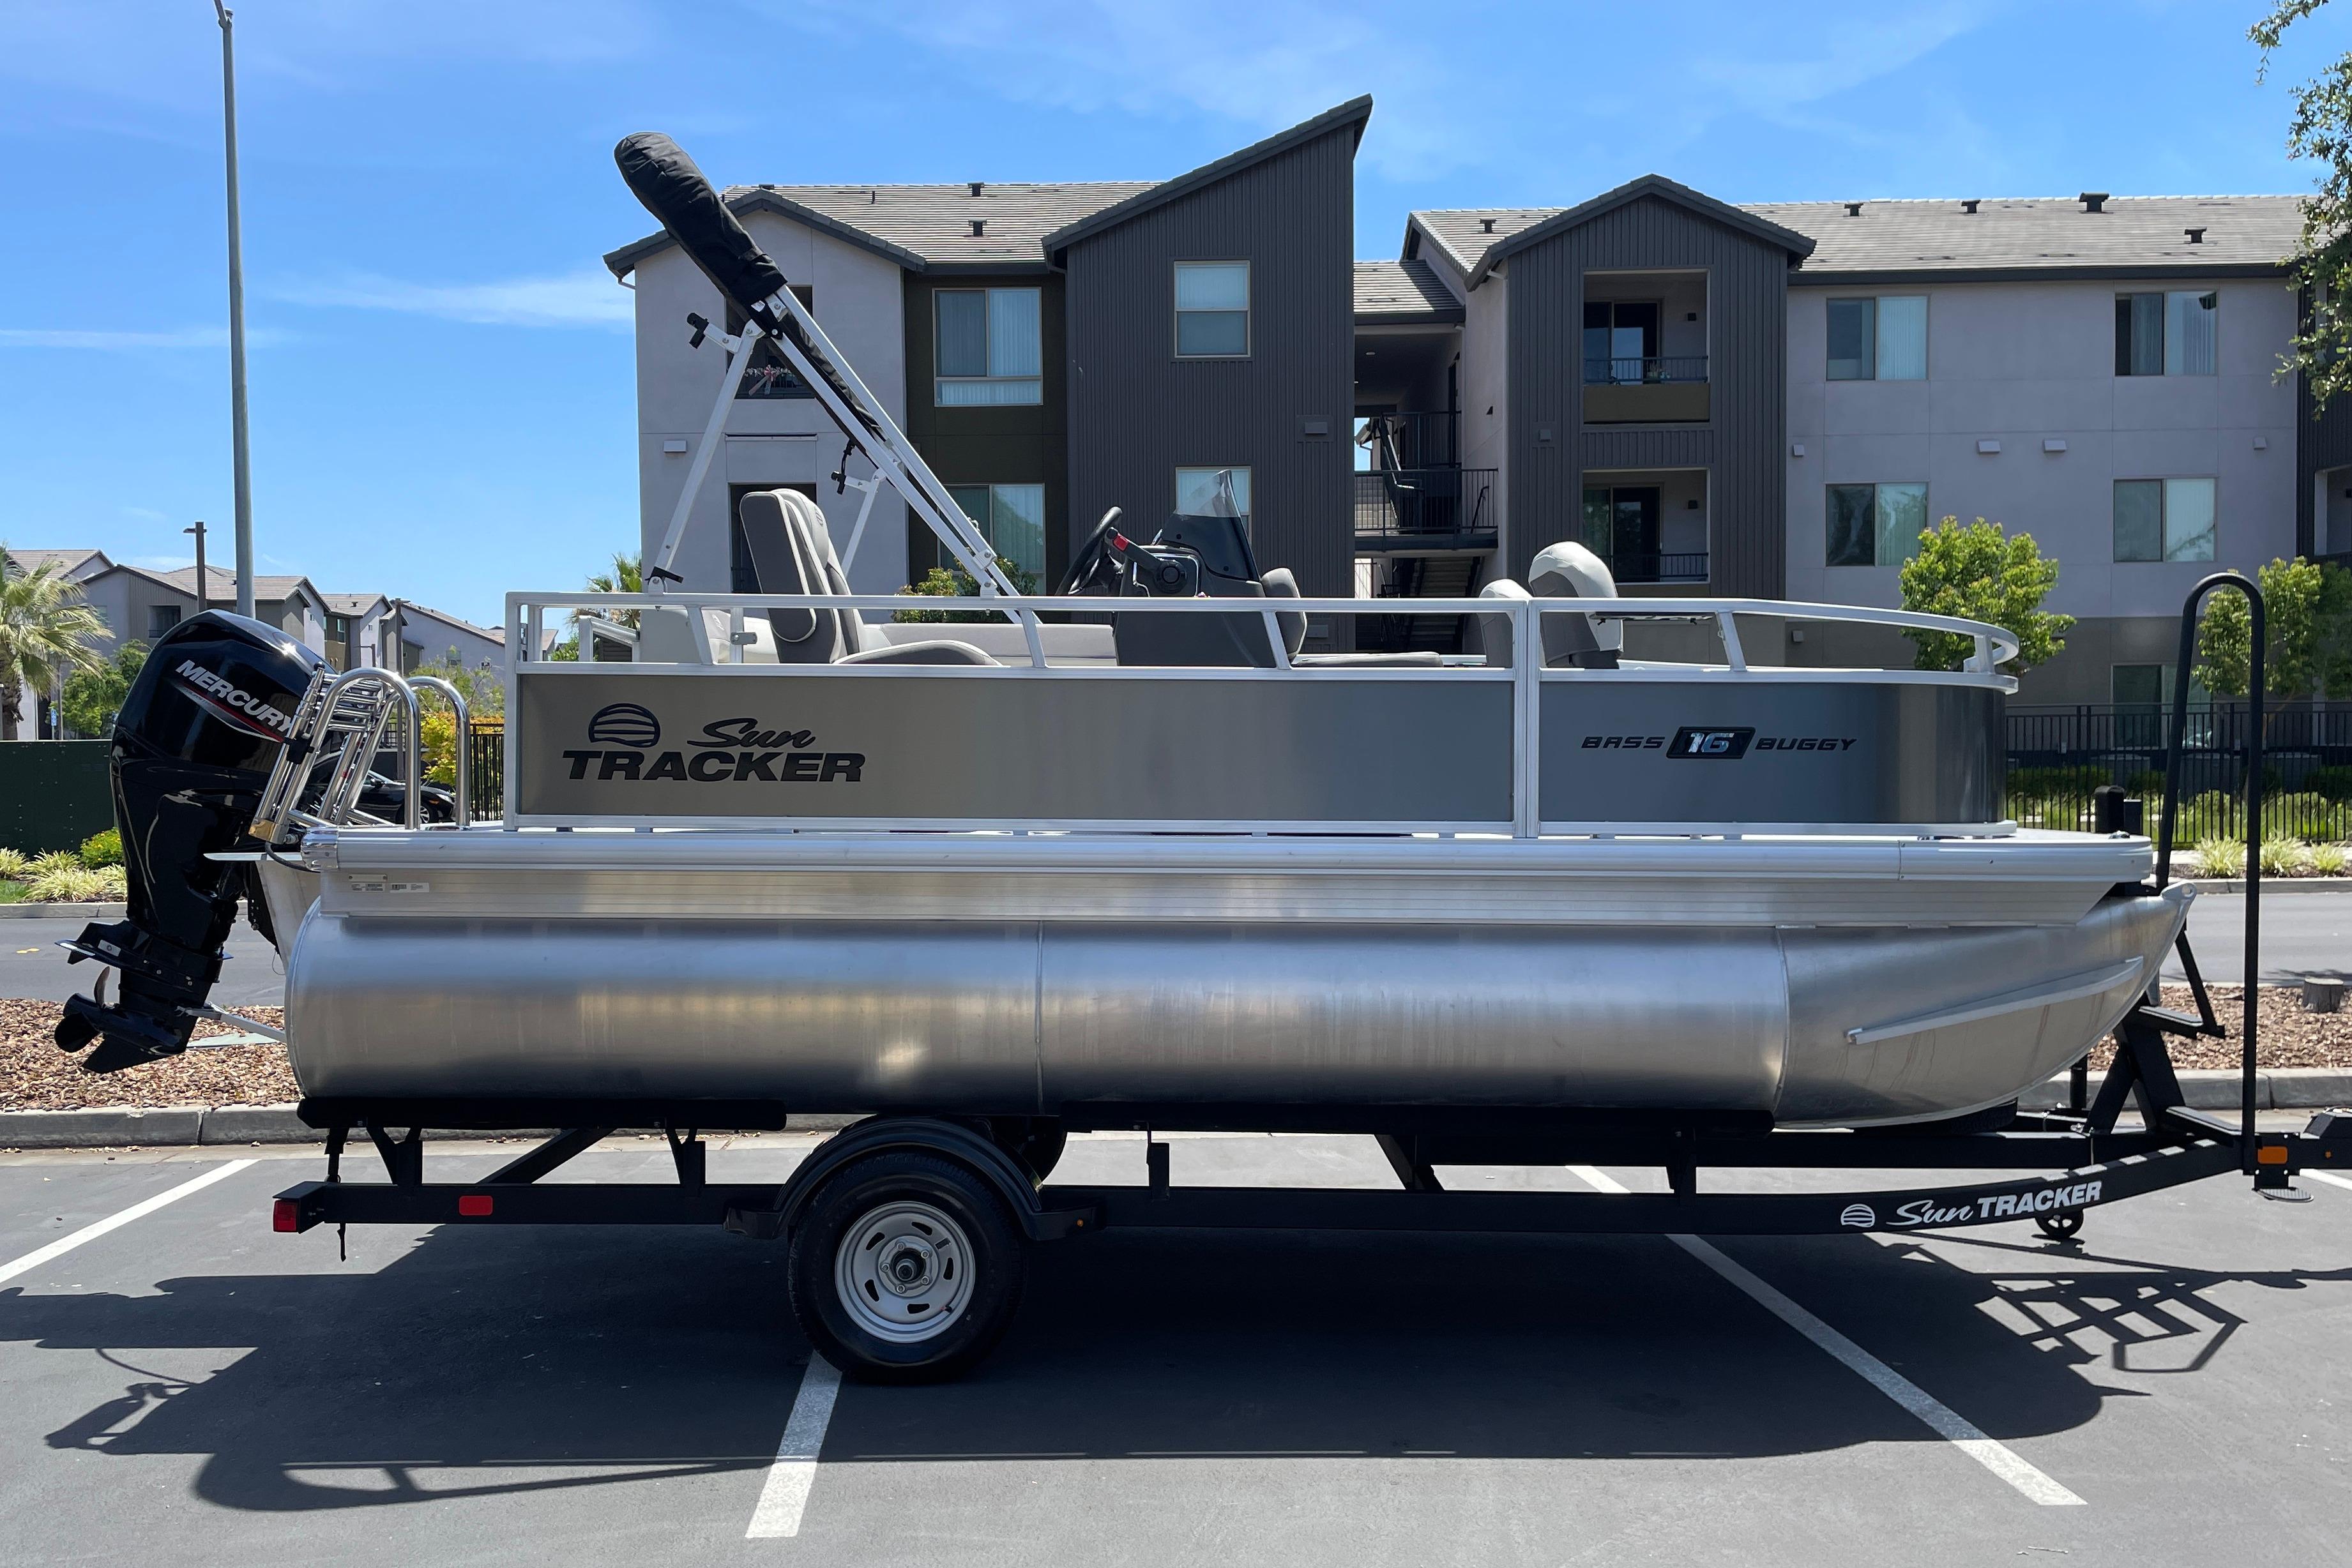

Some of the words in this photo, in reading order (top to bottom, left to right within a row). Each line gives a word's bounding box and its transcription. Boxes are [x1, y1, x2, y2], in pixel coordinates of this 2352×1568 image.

[175, 660, 292, 732] MERCURY
[687, 718, 816, 748] Sun
[1581, 736, 1665, 749] BASS
[1687, 732, 1735, 753] 16
[1754, 737, 1858, 751] BUGGY
[562, 750, 866, 782] TRACKER
[1886, 1200, 1974, 1225] Sun
[1976, 1180, 2102, 1219] TRACKER
